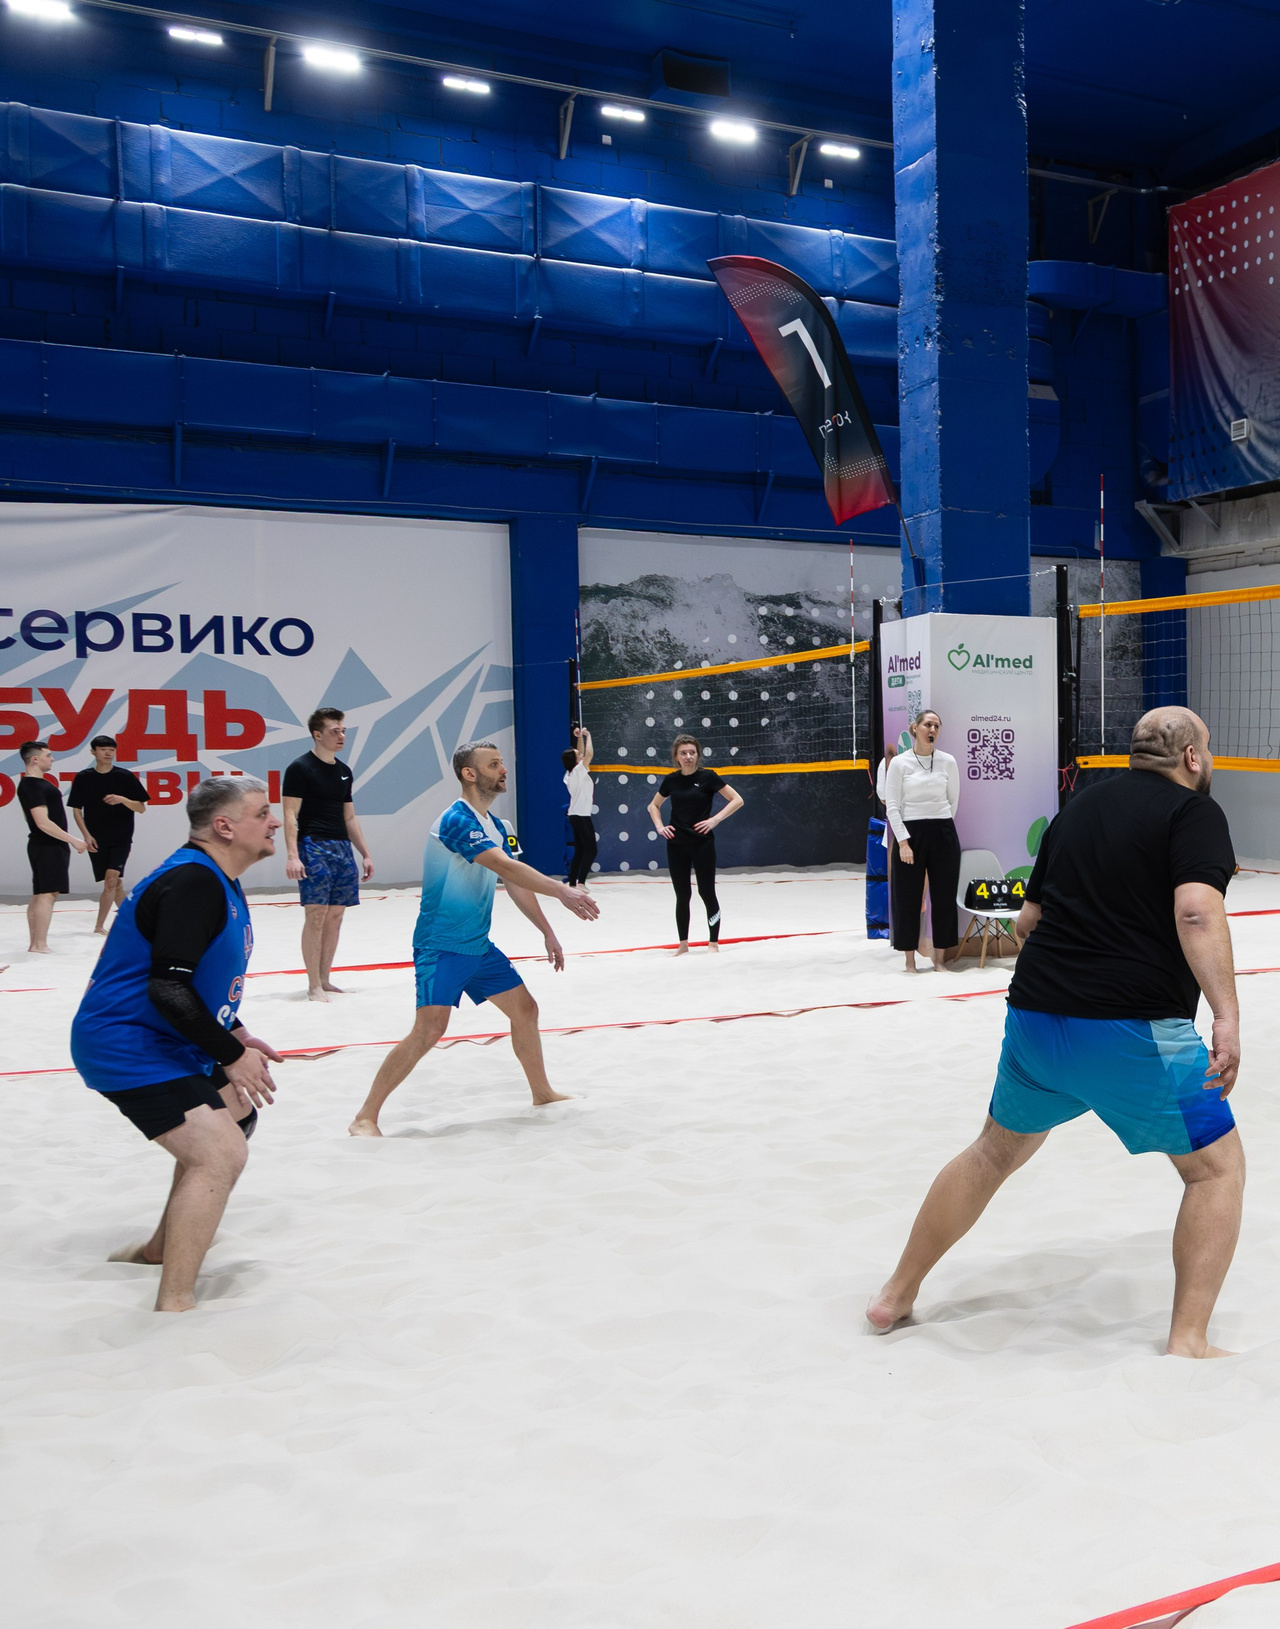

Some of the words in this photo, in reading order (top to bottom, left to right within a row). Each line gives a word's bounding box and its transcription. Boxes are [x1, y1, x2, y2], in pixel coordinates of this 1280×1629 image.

[887, 651, 921, 674] Al'med
[972, 653, 1033, 669] Al'med
[0, 687, 266, 762] БУДЬ
[970, 714, 1012, 722] almed24.ru
[976, 882, 989, 899] 4
[991, 884, 998, 895] 0
[1001, 884, 1008, 894] 0
[1011, 881, 1025, 898] 4
